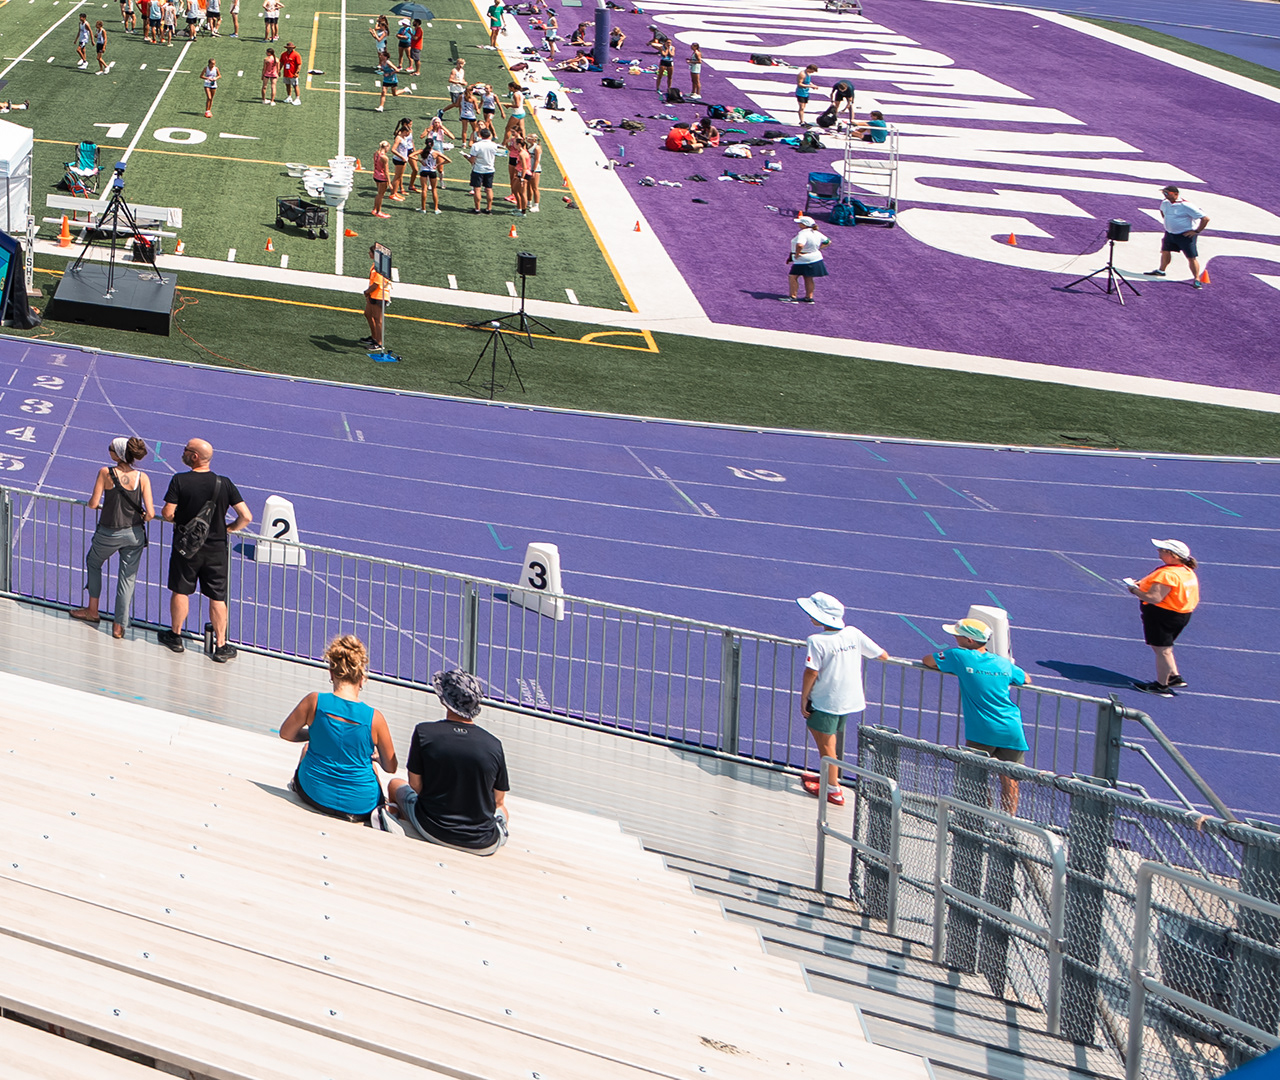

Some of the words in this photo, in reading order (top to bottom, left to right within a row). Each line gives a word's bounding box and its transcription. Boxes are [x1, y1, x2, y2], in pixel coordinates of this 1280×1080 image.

[93, 122, 208, 145] 10
[47, 353, 69, 367] 1
[32, 375, 65, 390] 2
[20, 399, 54, 414] 3
[5, 426, 37, 443] 4
[272, 518, 290, 541] 2
[528, 561, 547, 589] 3
